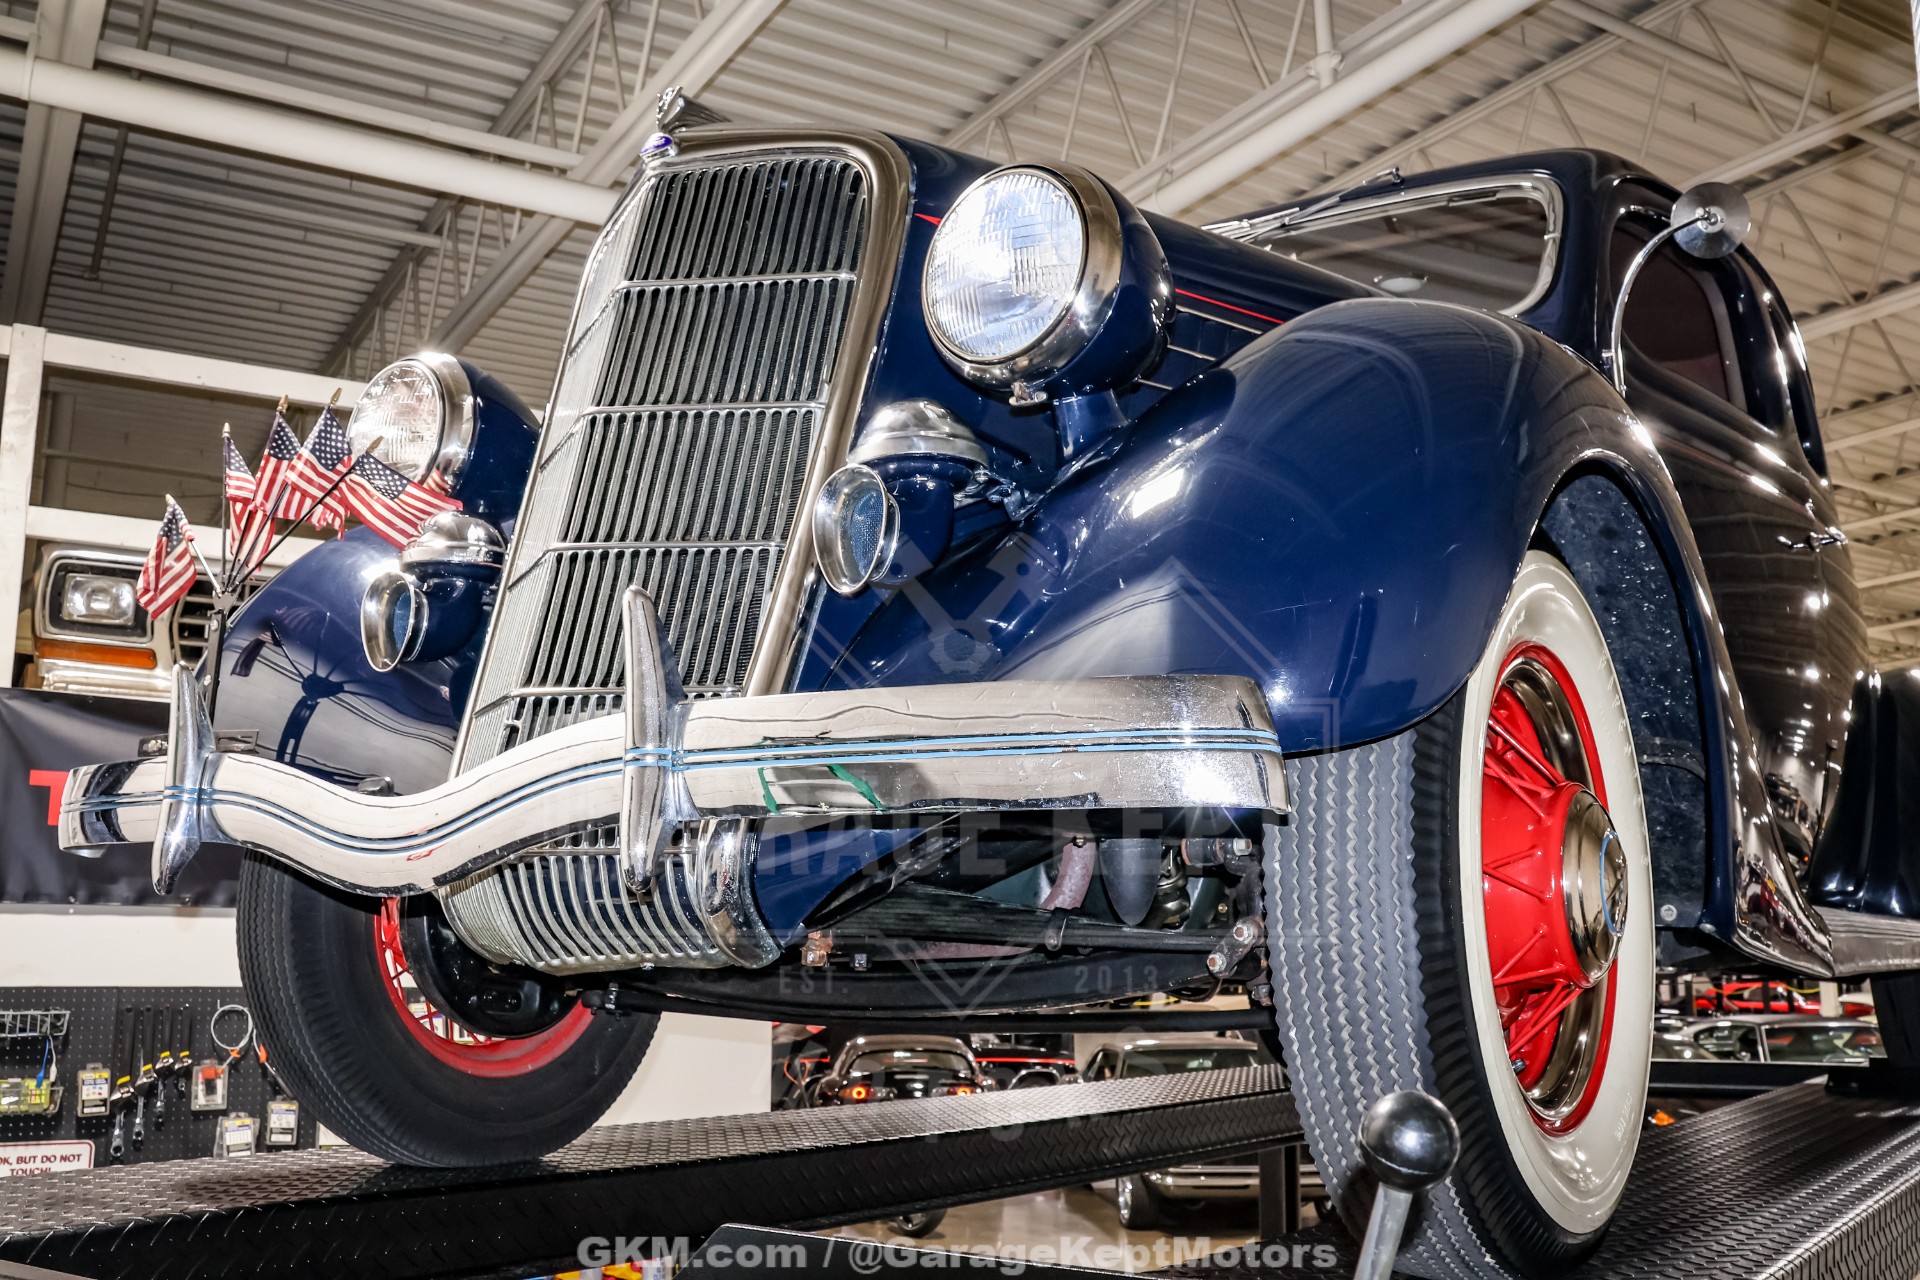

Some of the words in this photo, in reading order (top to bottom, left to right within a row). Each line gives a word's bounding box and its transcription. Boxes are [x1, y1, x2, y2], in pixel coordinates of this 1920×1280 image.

[16, 1155, 38, 1165] BUT
[41, 1154, 57, 1164] DO
[60, 1153, 82, 1163] NOT
